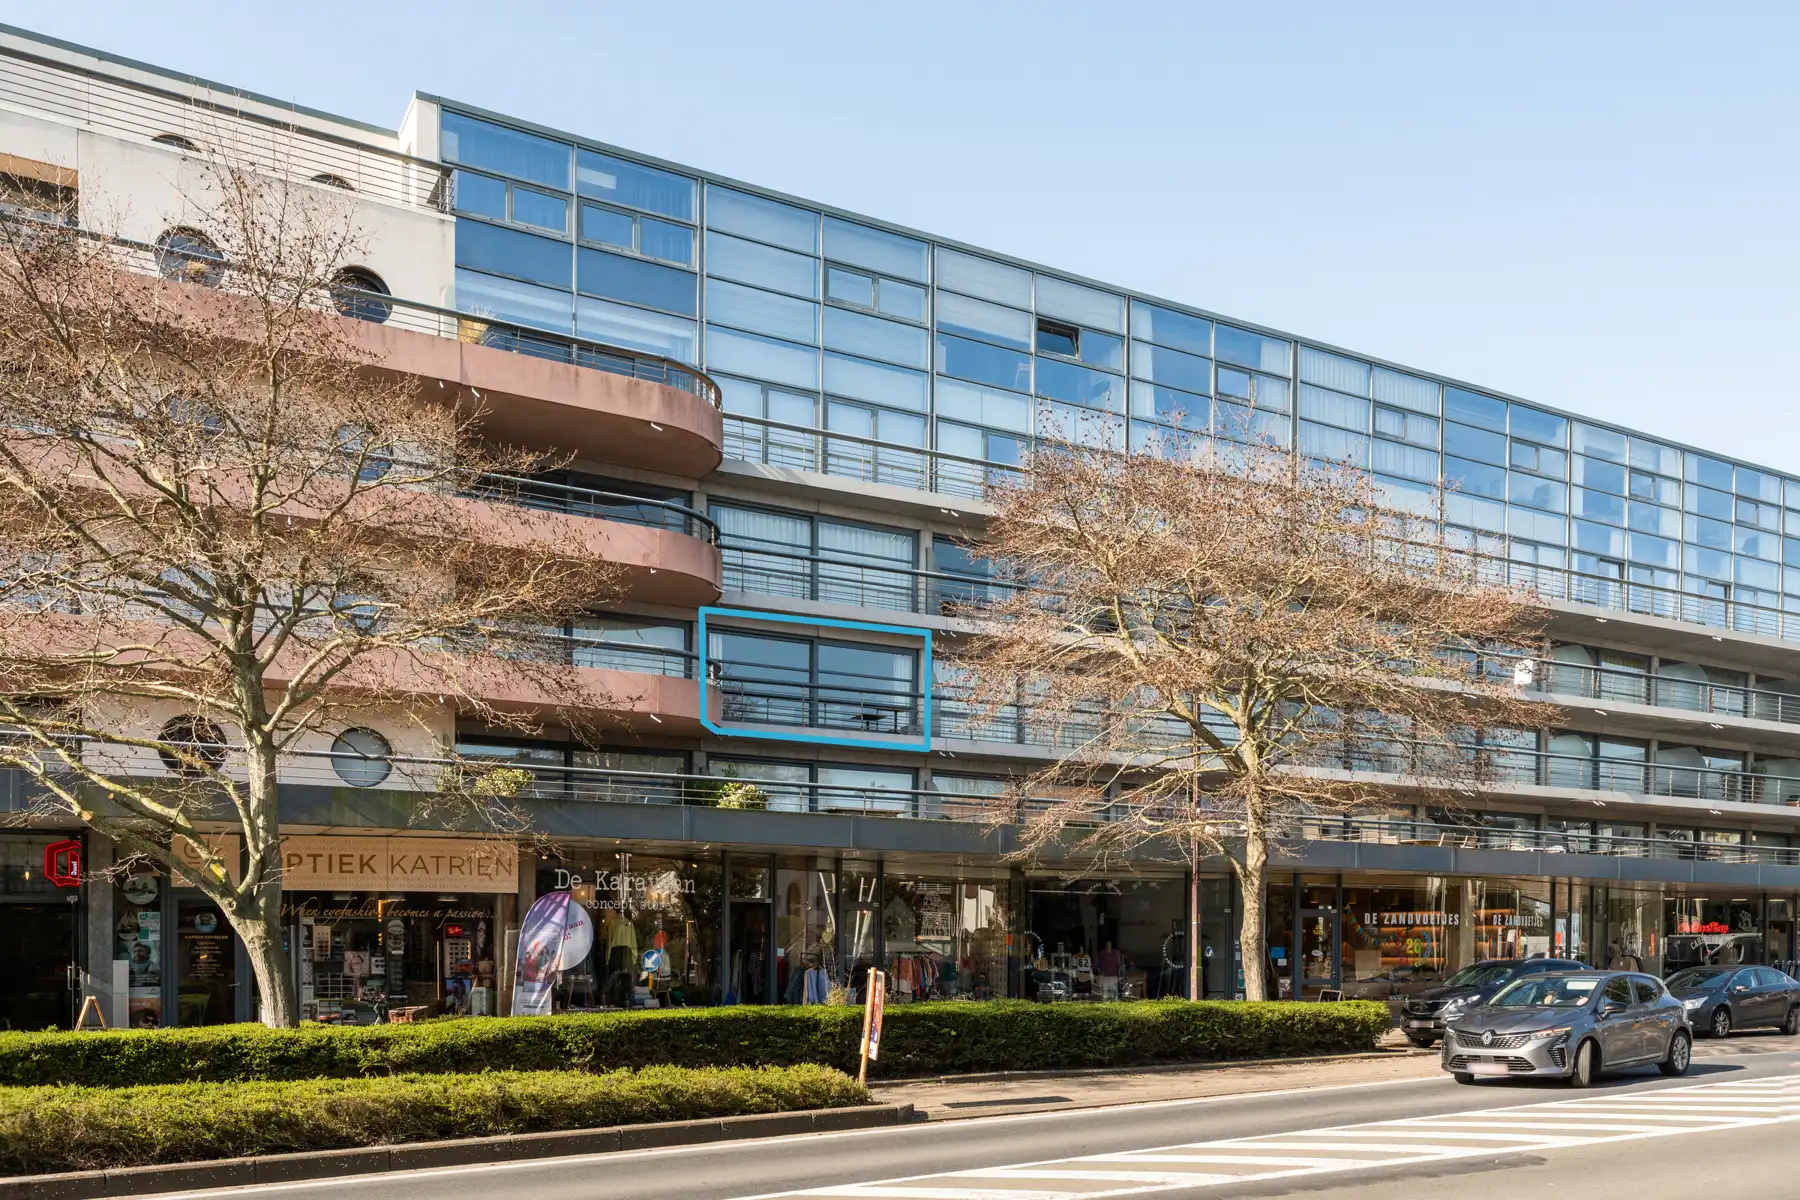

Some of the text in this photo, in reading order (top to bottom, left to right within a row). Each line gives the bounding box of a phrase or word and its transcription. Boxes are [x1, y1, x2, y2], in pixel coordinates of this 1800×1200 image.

[286, 853, 512, 877] PTIEK KATRIEN
[554, 868, 582, 890] De
[280, 896, 320, 917] When
[388, 899, 430, 918] becomes
[433, 907, 445, 917] a
[586, 900, 634, 913] concept
[1364, 912, 1460, 926] DE ZANDVOETJES
[1492, 914, 1502, 926] DE
